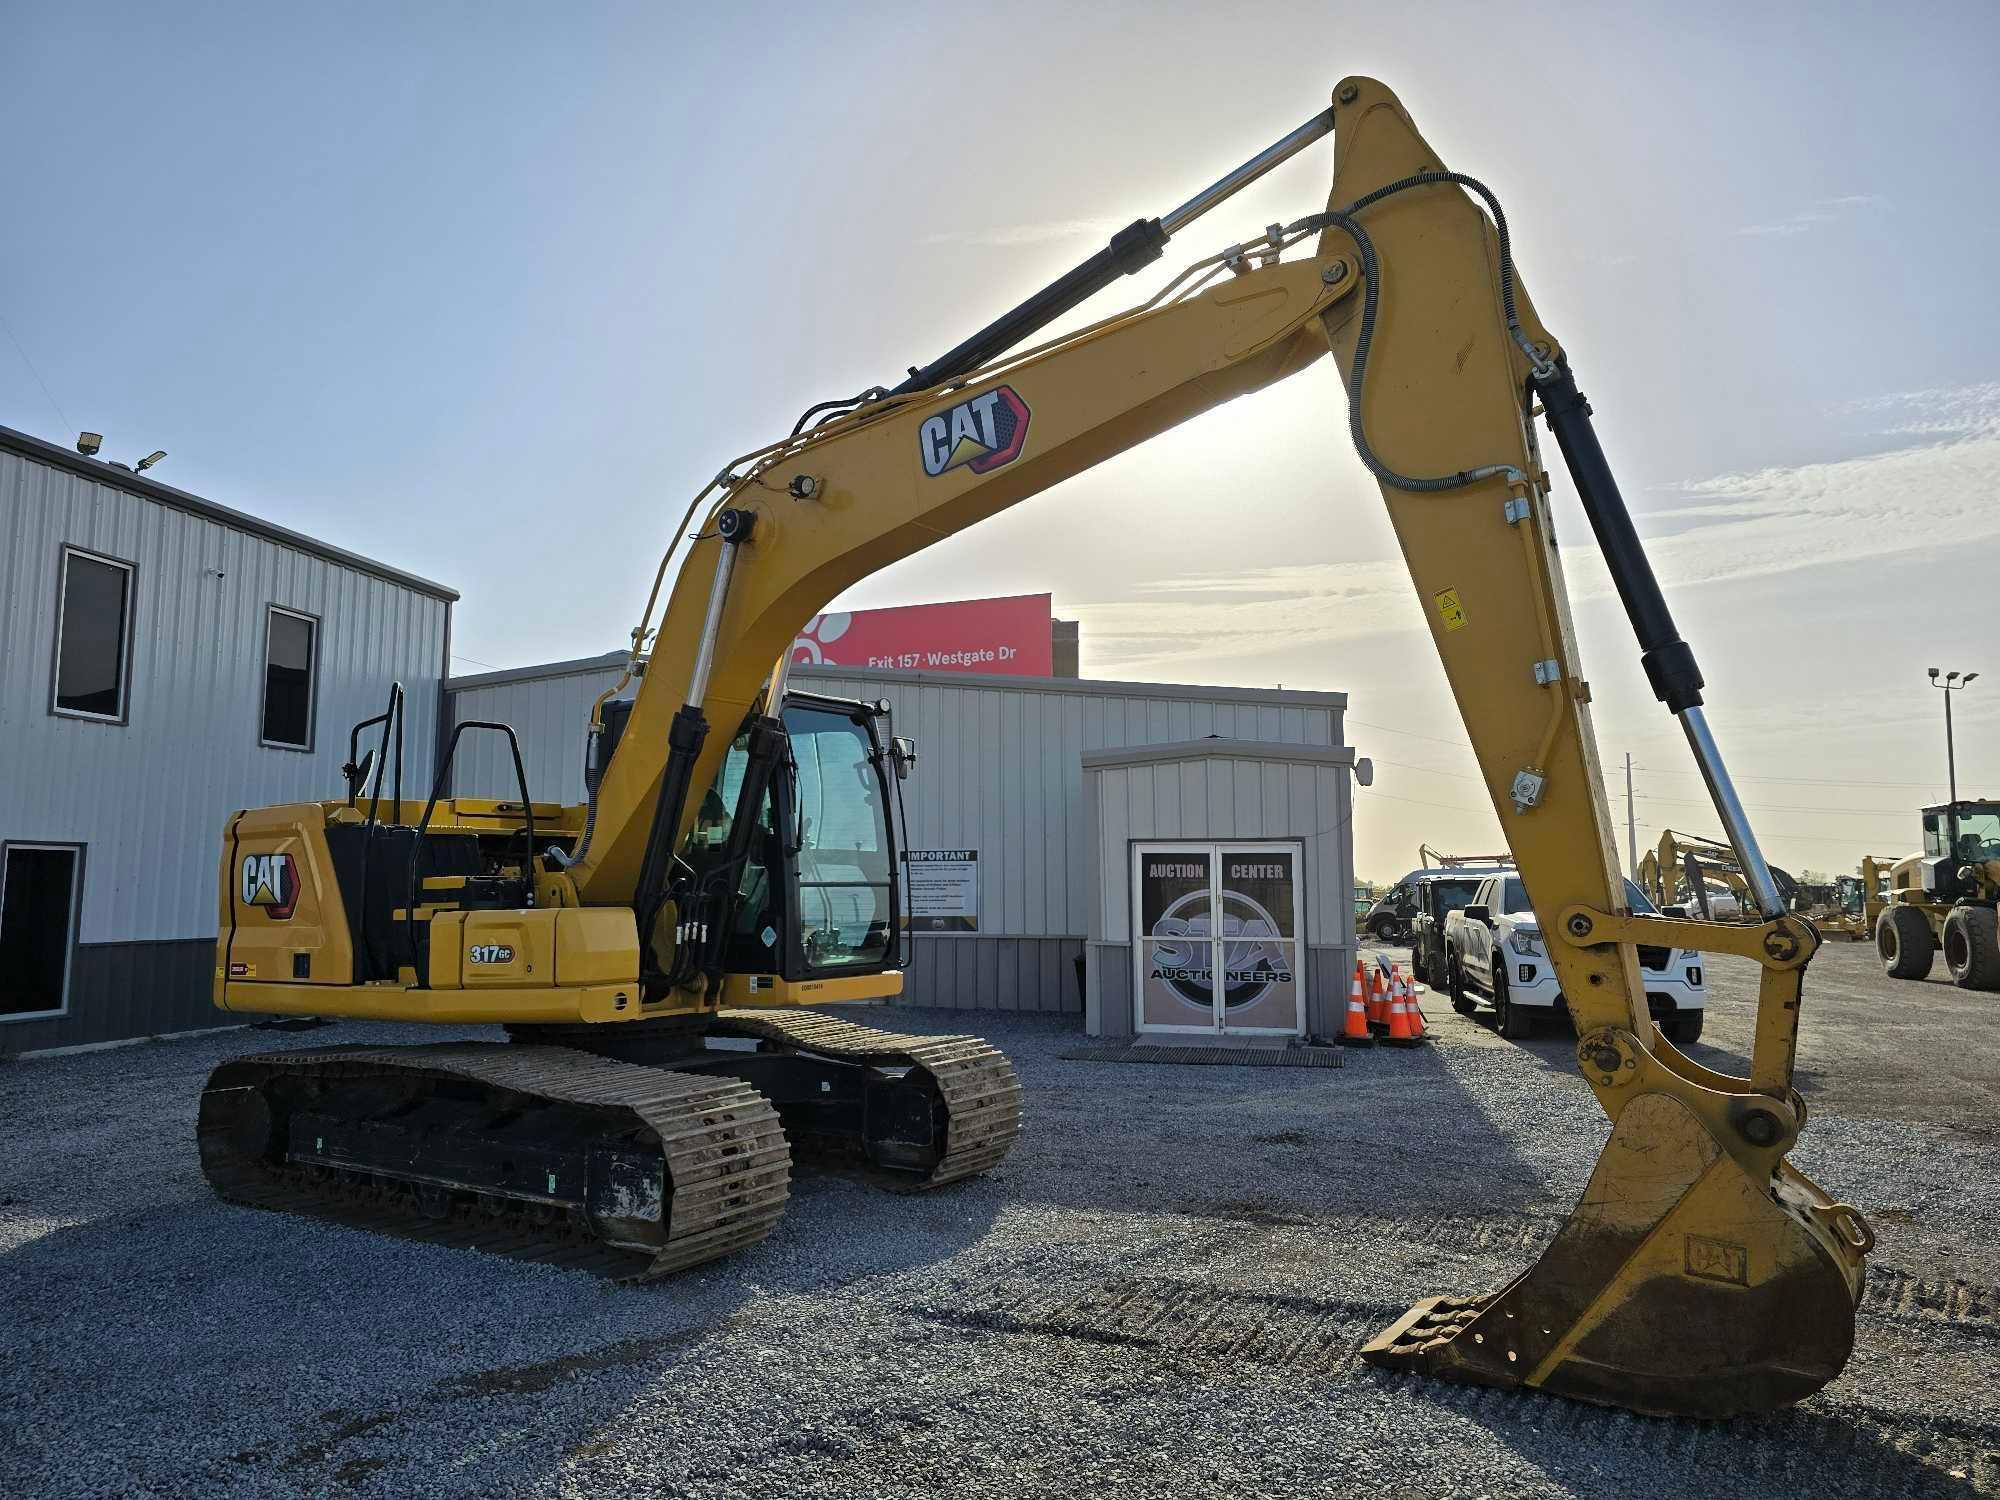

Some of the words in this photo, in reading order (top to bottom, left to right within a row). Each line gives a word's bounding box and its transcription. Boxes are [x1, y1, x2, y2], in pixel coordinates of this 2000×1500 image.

[920, 390, 999, 475] CAT
[868, 655, 894, 669] Exit
[898, 653, 920, 669] 157
[927, 648, 995, 667] Westgate
[998, 646, 1017, 660] Dr
[242, 855, 286, 904] CAT
[1149, 863, 1204, 878] AUCTION
[1231, 864, 1284, 879] CENTER
[470, 945, 499, 963] 317
[499, 949, 511, 959] GC
[1151, 917, 1291, 971] STA
